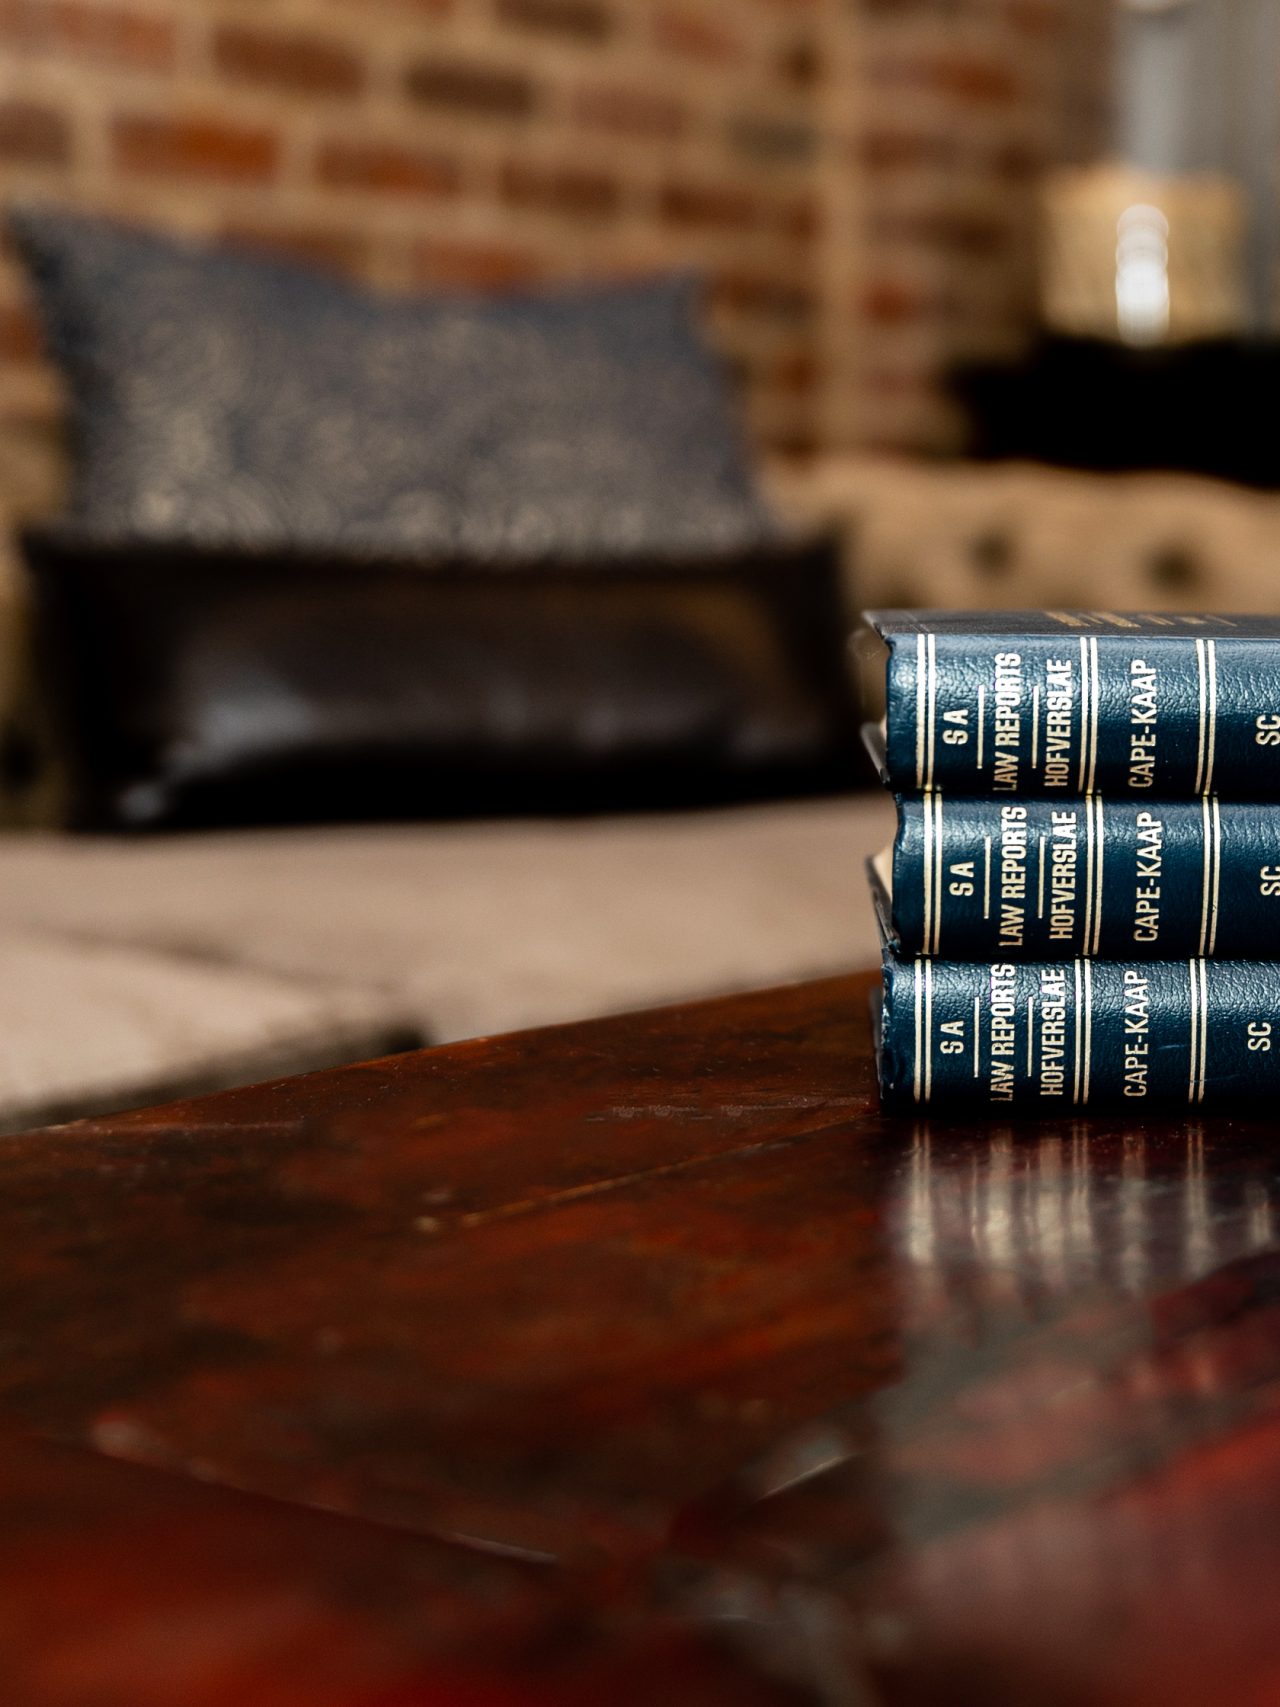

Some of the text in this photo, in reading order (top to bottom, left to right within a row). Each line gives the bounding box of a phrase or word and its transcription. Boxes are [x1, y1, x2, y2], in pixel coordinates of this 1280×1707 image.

[993, 652, 1021, 790] LAW REPORTS
[1044, 659, 1071, 787] HOFVERSLAE
[1128, 659, 1157, 788] CAPE-KAAP
[999, 806, 1027, 946] LAW REPORTS
[1049, 811, 1077, 940] HOFVERSLAE
[1133, 812, 1162, 942] CAPE-KAAP
[990, 964, 1015, 1101] LAW REPORTS
[1040, 969, 1066, 1096] HOFVERSLAE
[1124, 971, 1148, 1097] CAPE-KAAP
[1247, 1022, 1271, 1052] SC
